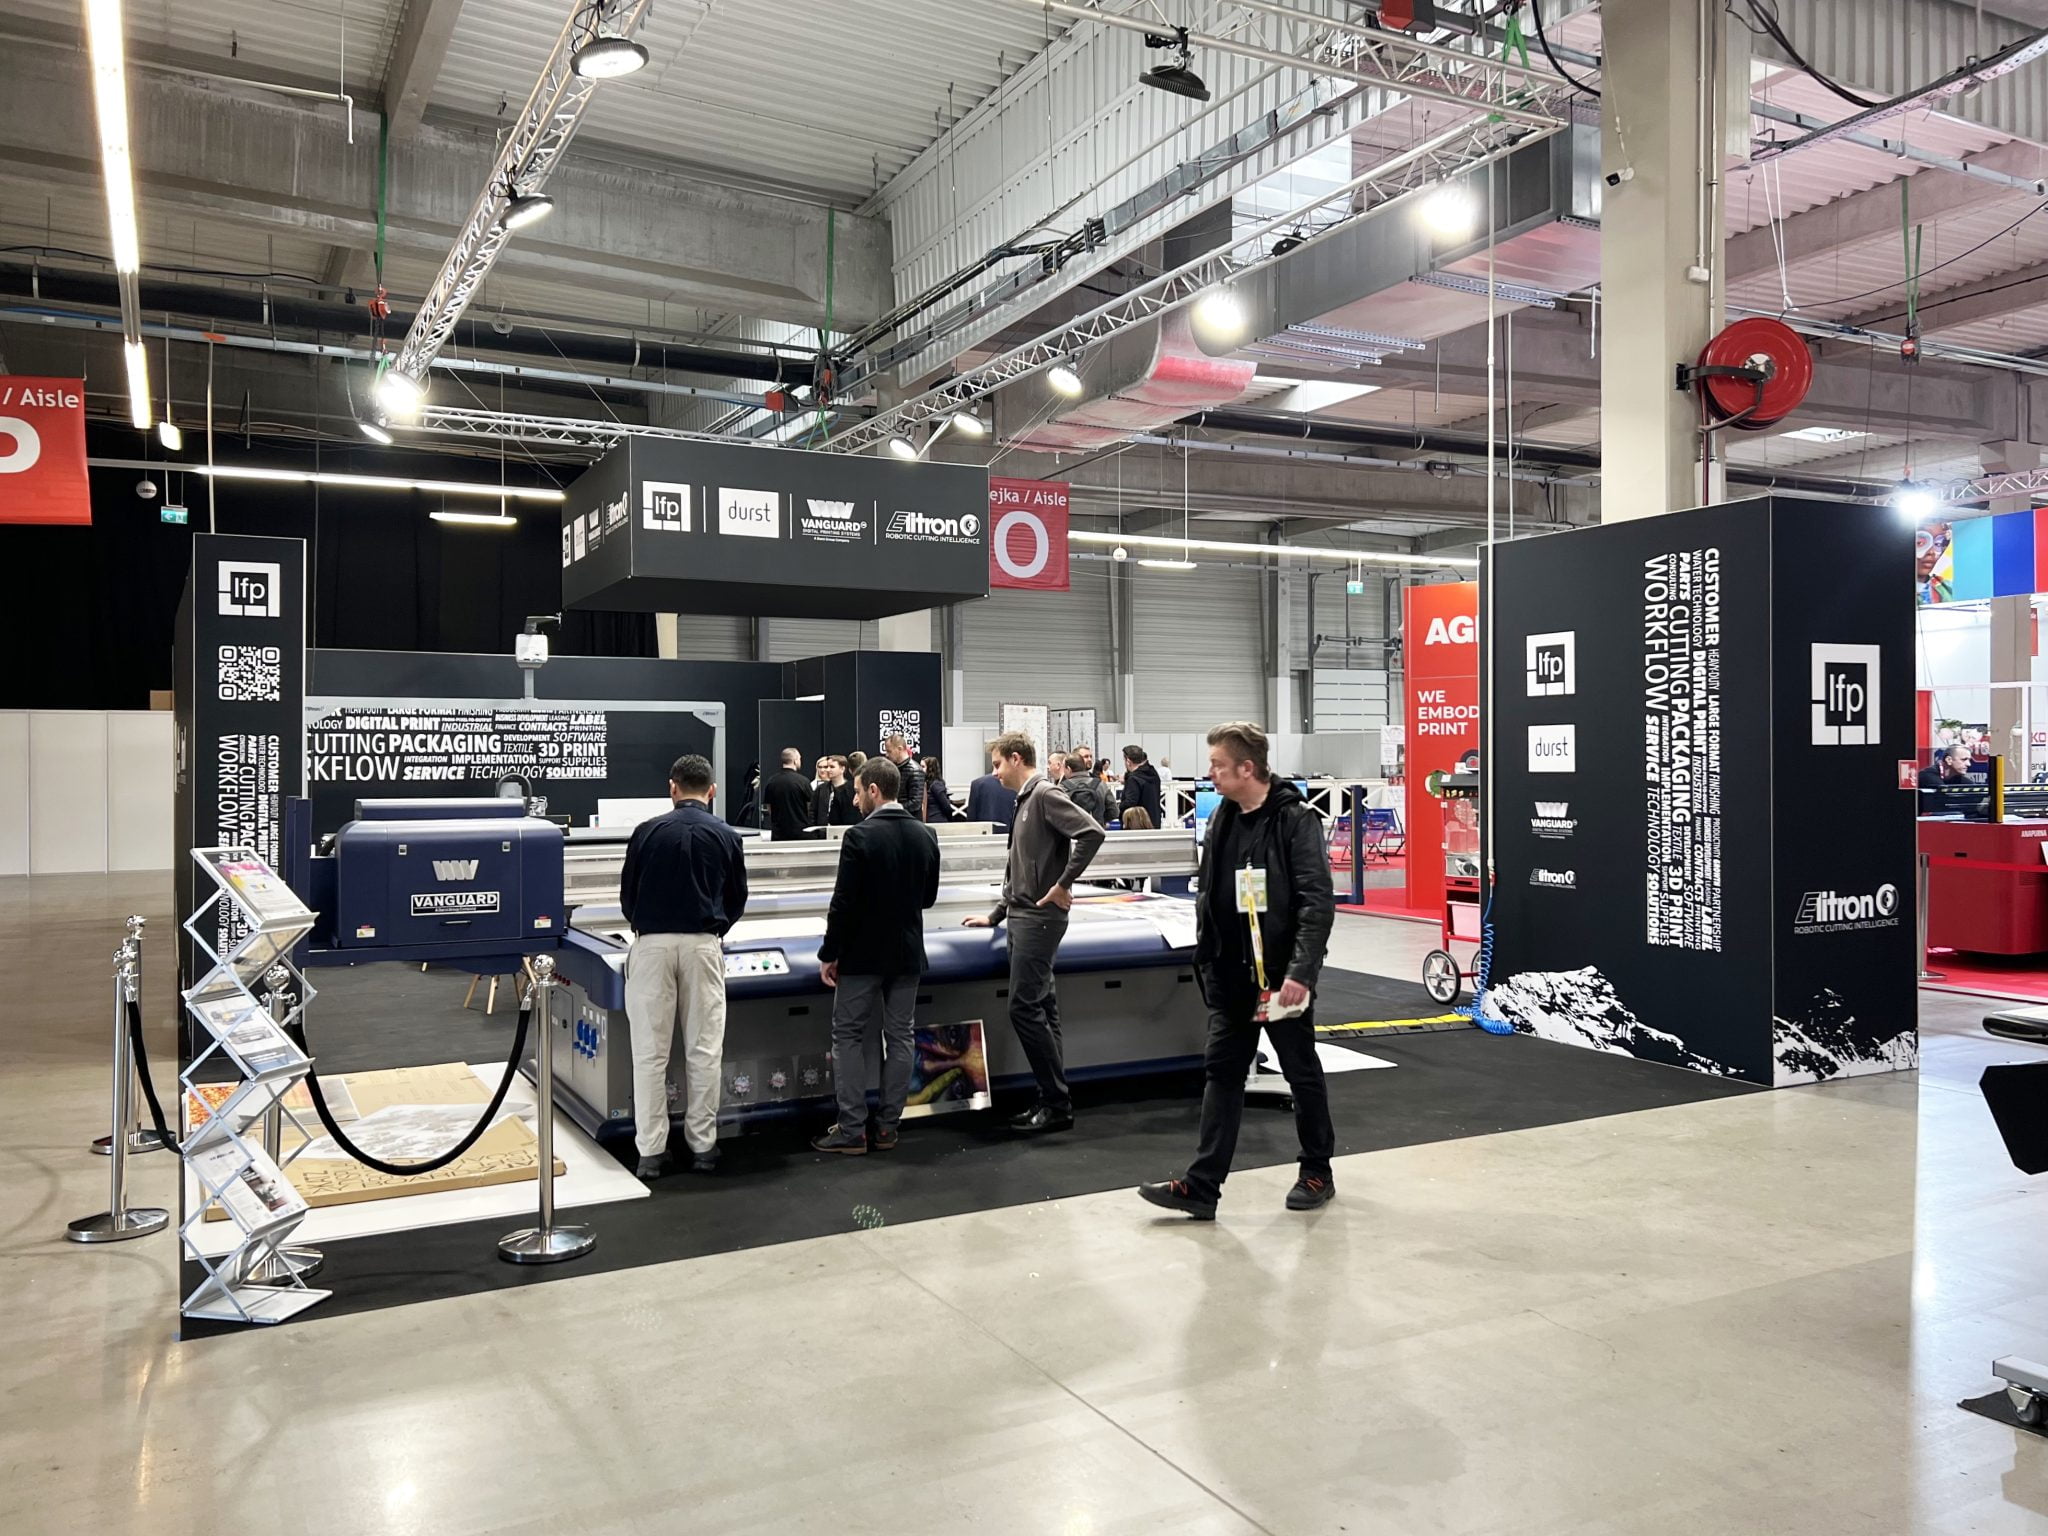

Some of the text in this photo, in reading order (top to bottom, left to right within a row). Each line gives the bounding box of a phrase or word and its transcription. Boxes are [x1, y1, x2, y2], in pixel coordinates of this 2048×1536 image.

[3, 387, 79, 408] / Aisle
[655, 496, 679, 519] lfp
[728, 496, 771, 523] durst
[1024, 489, 1030, 504] /
[1034, 490, 1066, 507] Aisle
[801, 518, 860, 531] VANGUARD
[886, 511, 958, 535] Elitron
[940, 536, 980, 544] INTELLIGENCE
[994, 510, 1049, 578] O
[1668, 553, 1676, 601] CONSULTING
[1680, 552, 1690, 600] PARTS
[1692, 550, 1702, 582] WATER
[235, 577, 265, 604] lfp
[1705, 548, 1720, 646] CUSTOMER
[1692, 584, 1702, 647] TECHNOLOGY
[1538, 652, 1563, 681] lfp
[1692, 651, 1706, 708] DIGITAL
[1708, 649, 1719, 690] HEAVY-DUTY
[1418, 690, 1446, 703] WE
[1708, 695, 1719, 727] LARGE
[1829, 672, 1864, 722] lfp
[346, 717, 399, 730] DIGITAL
[401, 718, 440, 731] PRINT
[441, 723, 493, 732] INDUSTRIAL
[518, 722, 567, 731] CONTRACTS
[517, 714, 548, 722] DEVELOPMENT
[571, 715, 607, 724] LABEL
[1418, 722, 1468, 736] PRINT
[1693, 710, 1706, 754] PRINT
[248, 735, 257, 764] PARTS
[258, 735, 266, 755] WATER
[389, 734, 501, 753] PACKAGING
[504, 743, 534, 753] TEXTILE
[538, 743, 559, 757] 3D
[563, 743, 607, 756] PRINT
[553, 732, 606, 742] SOFTWARE
[1536, 736, 1568, 756] durst
[1644, 554, 1669, 944] WORKFLOW SERVICE TECHNOLOGY SOLUTIONS
[1709, 730, 1719, 772] FORMAT
[258, 756, 266, 793] TECHNOLOGY
[268, 735, 280, 792] CUSTOMER
[403, 766, 466, 780] SERVICE
[546, 767, 607, 779] SOLUTIONS
[452, 755, 536, 764] IMPLEMENTATION
[562, 757, 607, 766] SUPPLIES
[1668, 605, 1691, 948] CUTTING PACKAGING TEXTILE 3D PRINT
[218, 734, 238, 829] WORKFLOW
[239, 766, 255, 820] CUTTING
[1692, 756, 1702, 814] INDUSTRIAL
[1709, 774, 1720, 814] FINISHING
[258, 794, 268, 828] DIGITAL
[1531, 819, 1572, 829] VANGUARD
[1661, 767, 1671, 862] IMPLEMENTATION
[258, 830, 268, 855] PRINT
[270, 820, 278, 840] LARGE
[1712, 818, 1720, 858] PRODUCTIVITY
[270, 841, 278, 866] FORMAT
[1530, 868, 1566, 884] Elitron
[1694, 844, 1703, 902] CONTRACTS
[414, 894, 497, 907] VANGUARD
[1684, 884, 1694, 949] SOFTWARE
[1794, 890, 1873, 924] Elitron
[1660, 892, 1669, 946] SUPPLIES
[1702, 906, 1712, 950] LABEL
[1712, 888, 1721, 952] PARTNERSHIP
[1794, 917, 1899, 935] ROBOTIC CUTTING INTELLIGENCE
